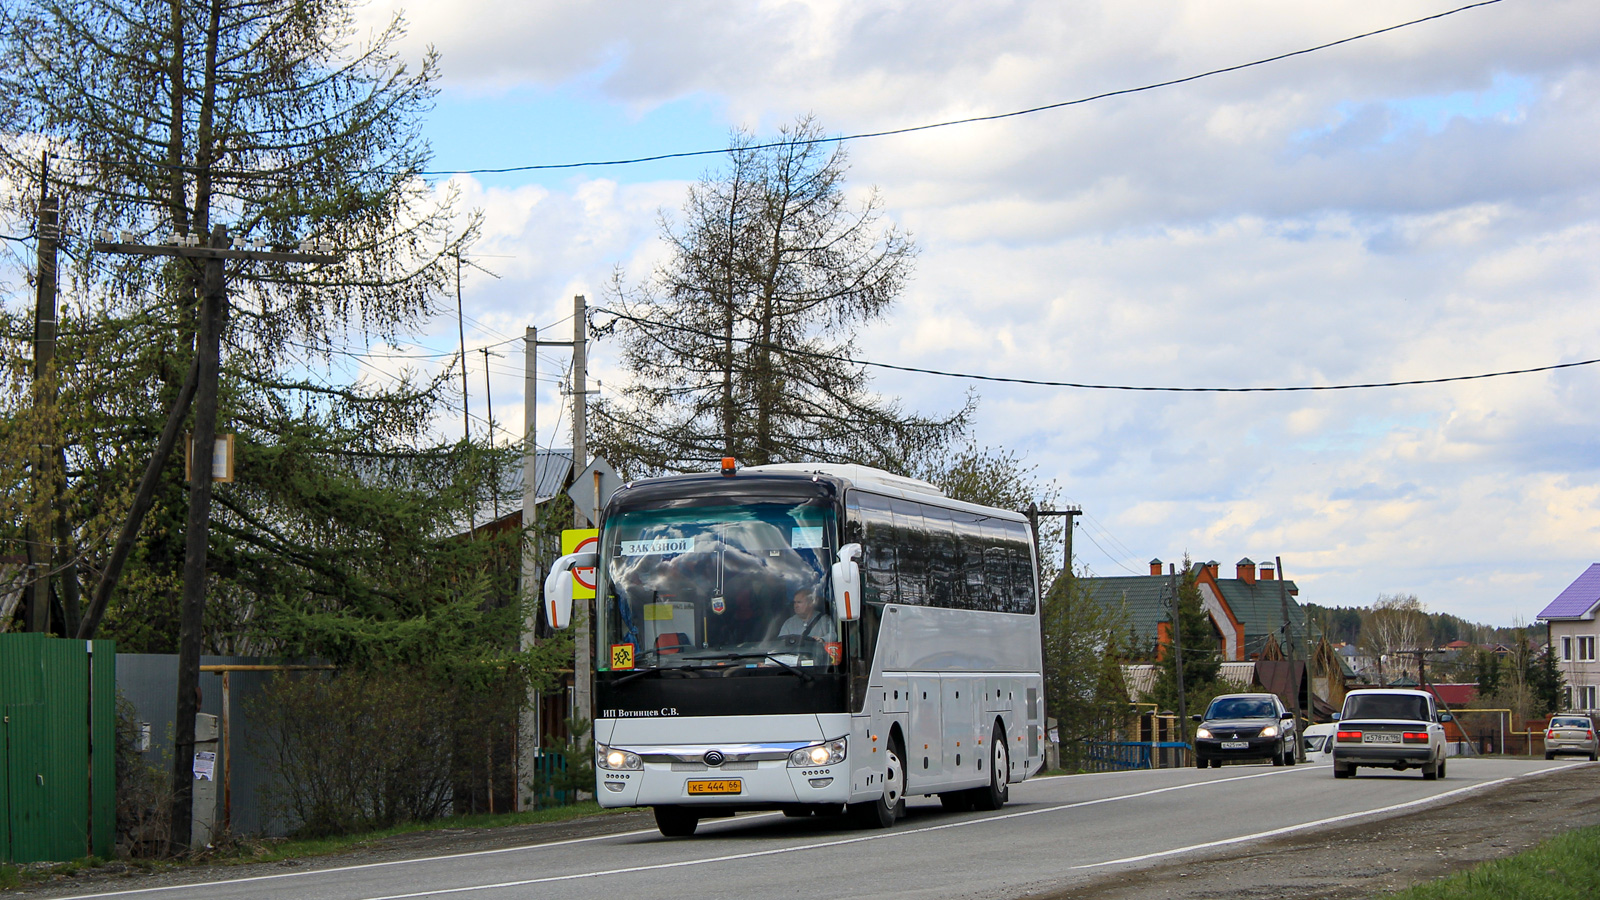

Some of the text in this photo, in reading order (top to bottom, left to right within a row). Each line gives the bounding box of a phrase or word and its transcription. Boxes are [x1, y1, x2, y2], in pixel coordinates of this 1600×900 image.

[629, 541, 687, 554] ЗАКАЗНОЙ
[603, 707, 680, 718] ИП Вотинцев С.В.
[692, 781, 738, 792] КЕ 444 66
